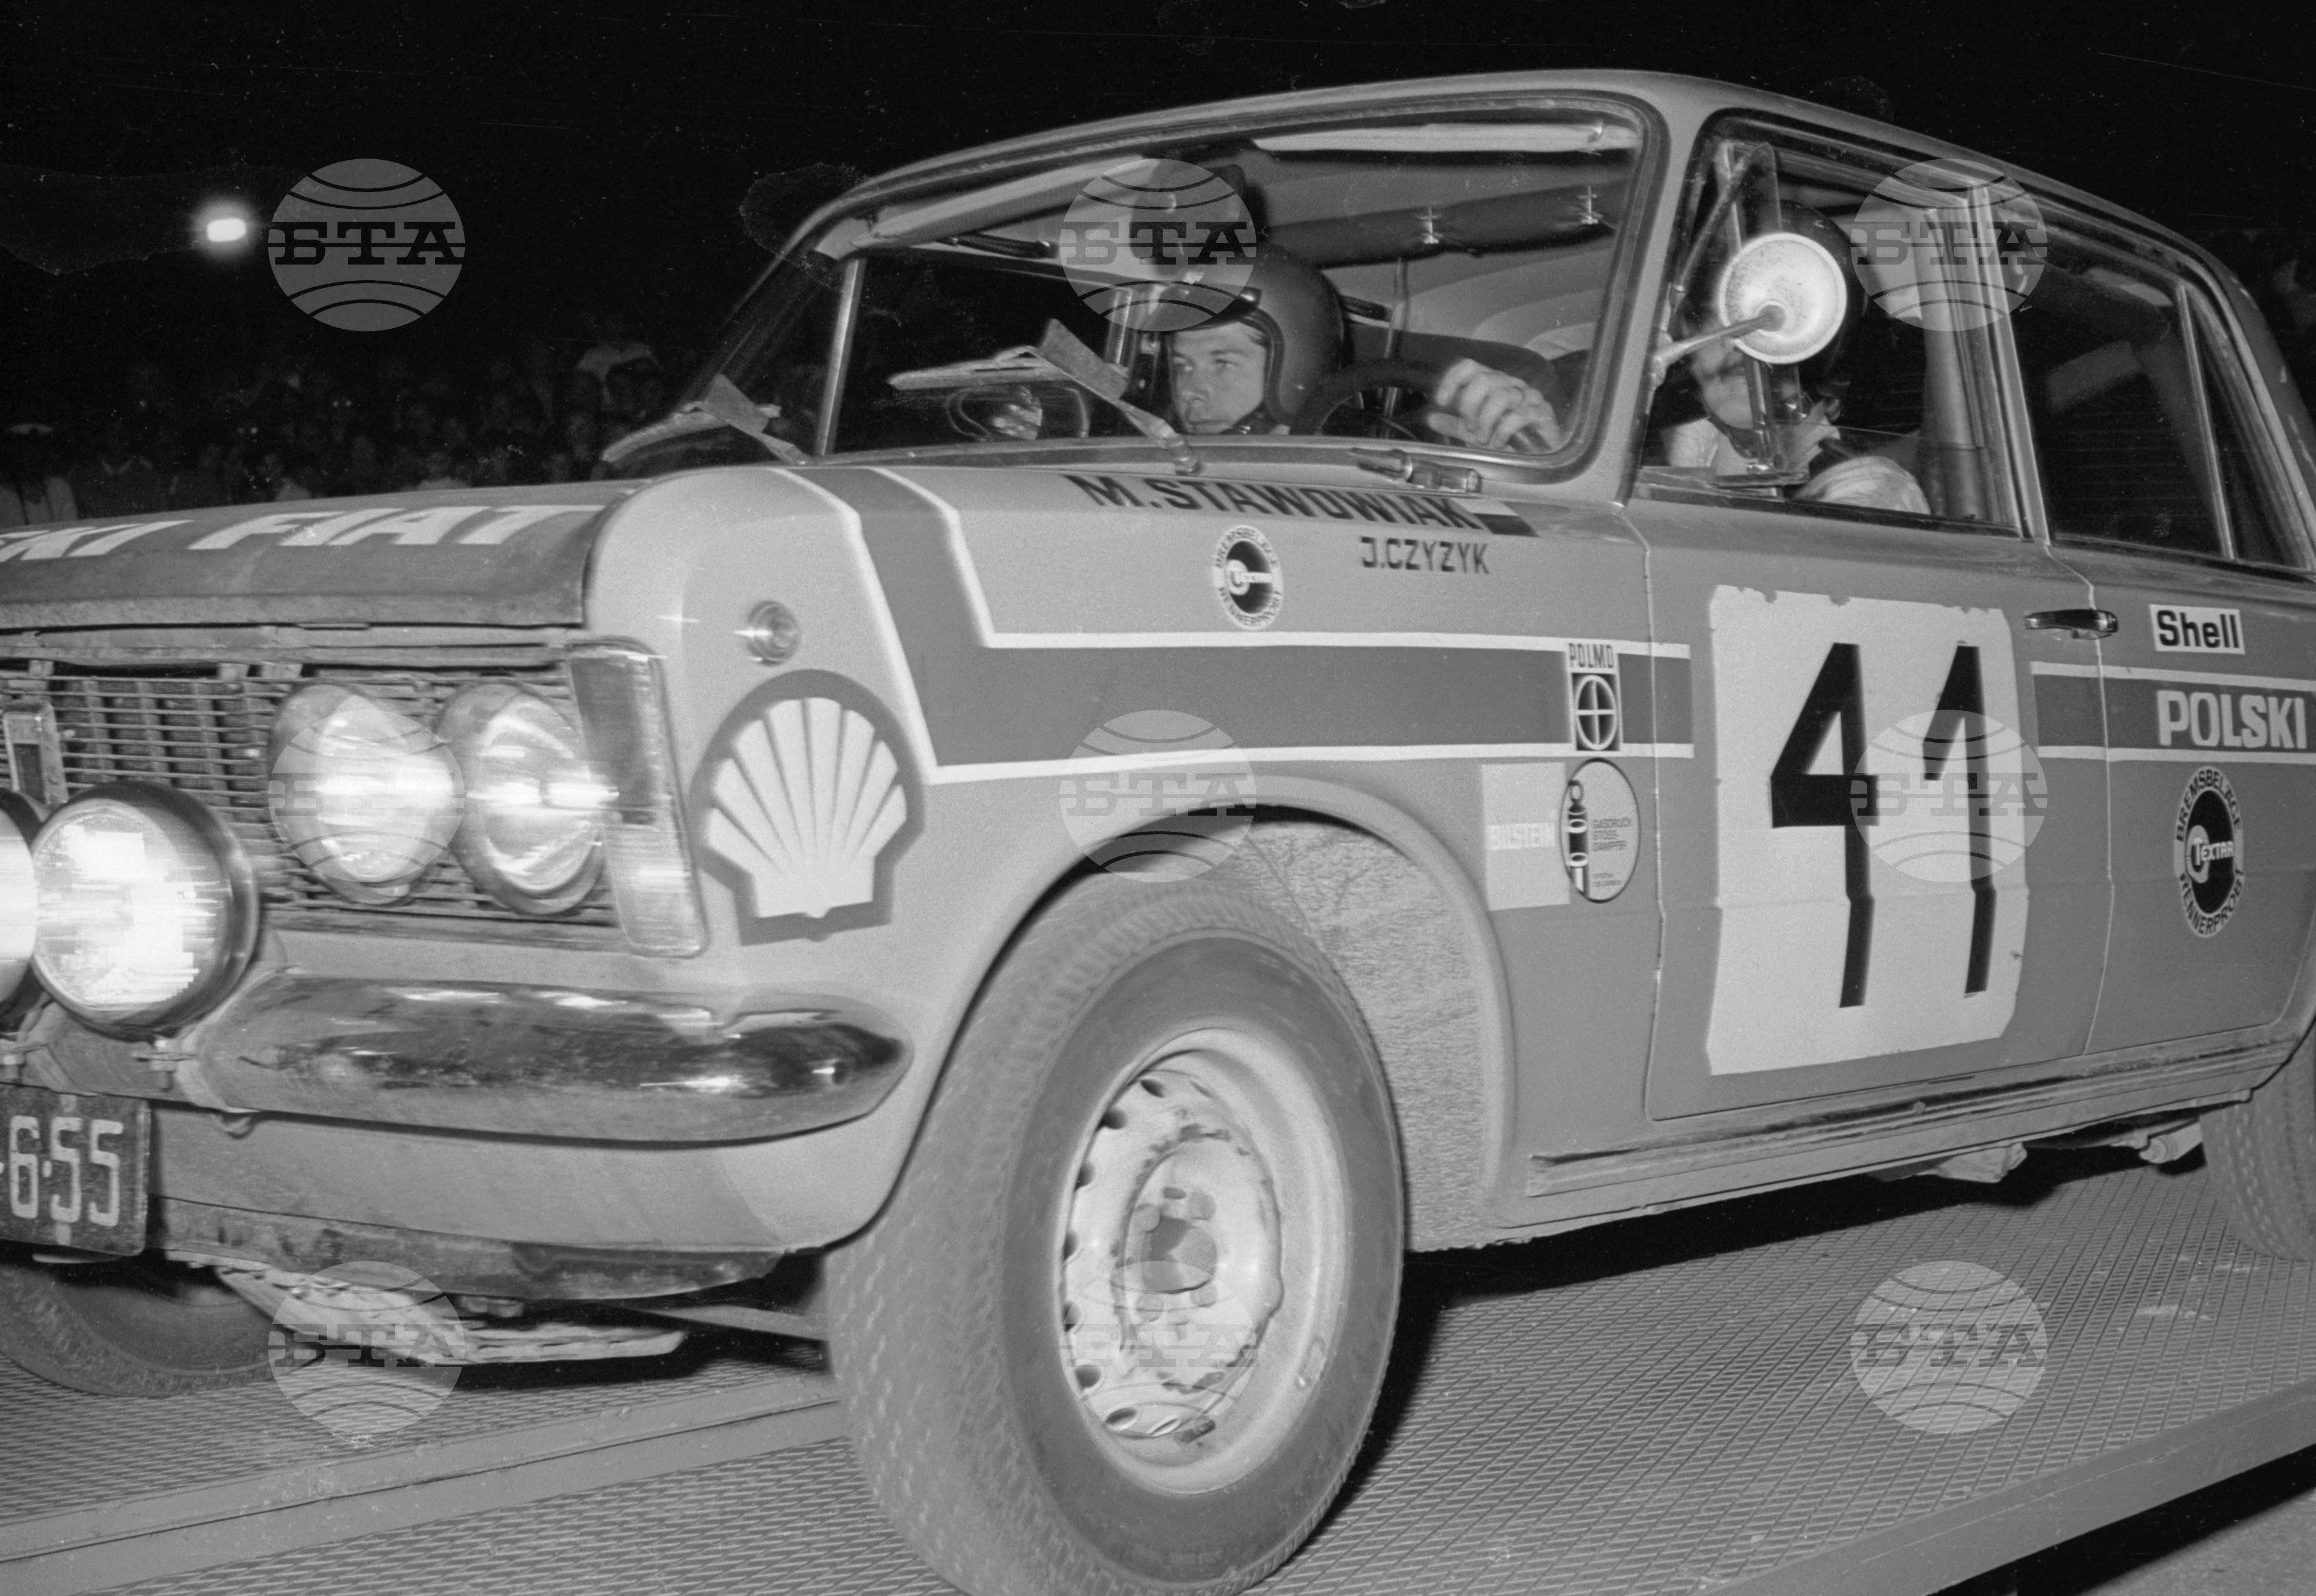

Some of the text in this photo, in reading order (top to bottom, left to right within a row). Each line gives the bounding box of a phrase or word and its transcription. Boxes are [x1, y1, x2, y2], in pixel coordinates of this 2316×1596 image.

[186, 505, 606, 550] FIAT
[2157, 610, 2240, 649] Shell
[1569, 643, 1614, 669] POLMO
[2157, 689, 2307, 749] POLSKI
[1770, 642, 1998, 1008] 41
